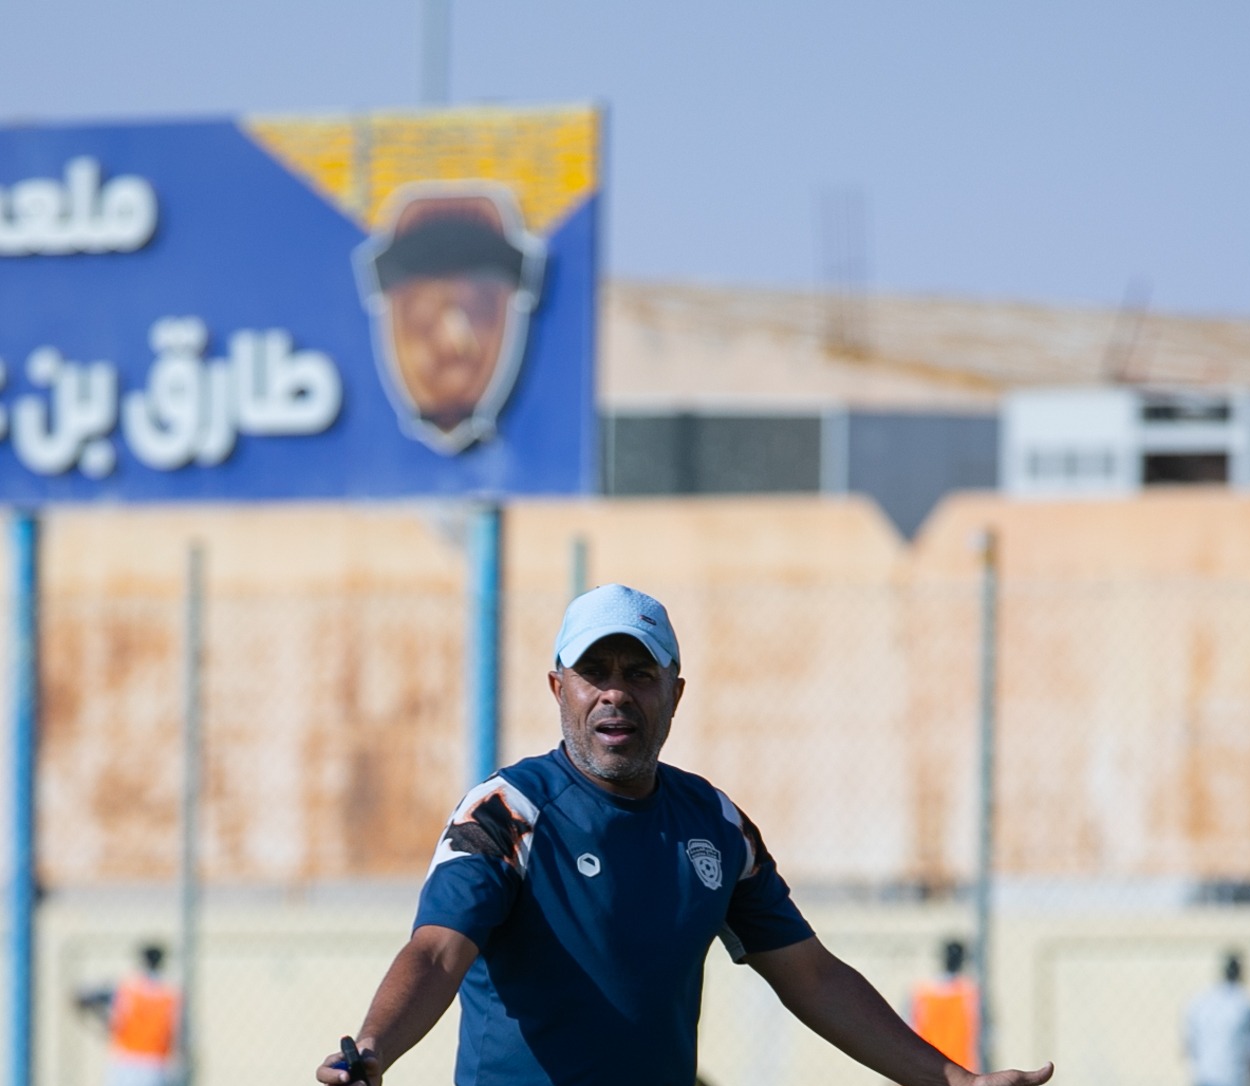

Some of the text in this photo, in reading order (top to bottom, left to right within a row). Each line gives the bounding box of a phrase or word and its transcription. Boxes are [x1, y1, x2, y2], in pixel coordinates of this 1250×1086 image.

[0, 154, 158, 255] ملع
[11, 344, 118, 480] بن
[121, 315, 342, 470] طارق
